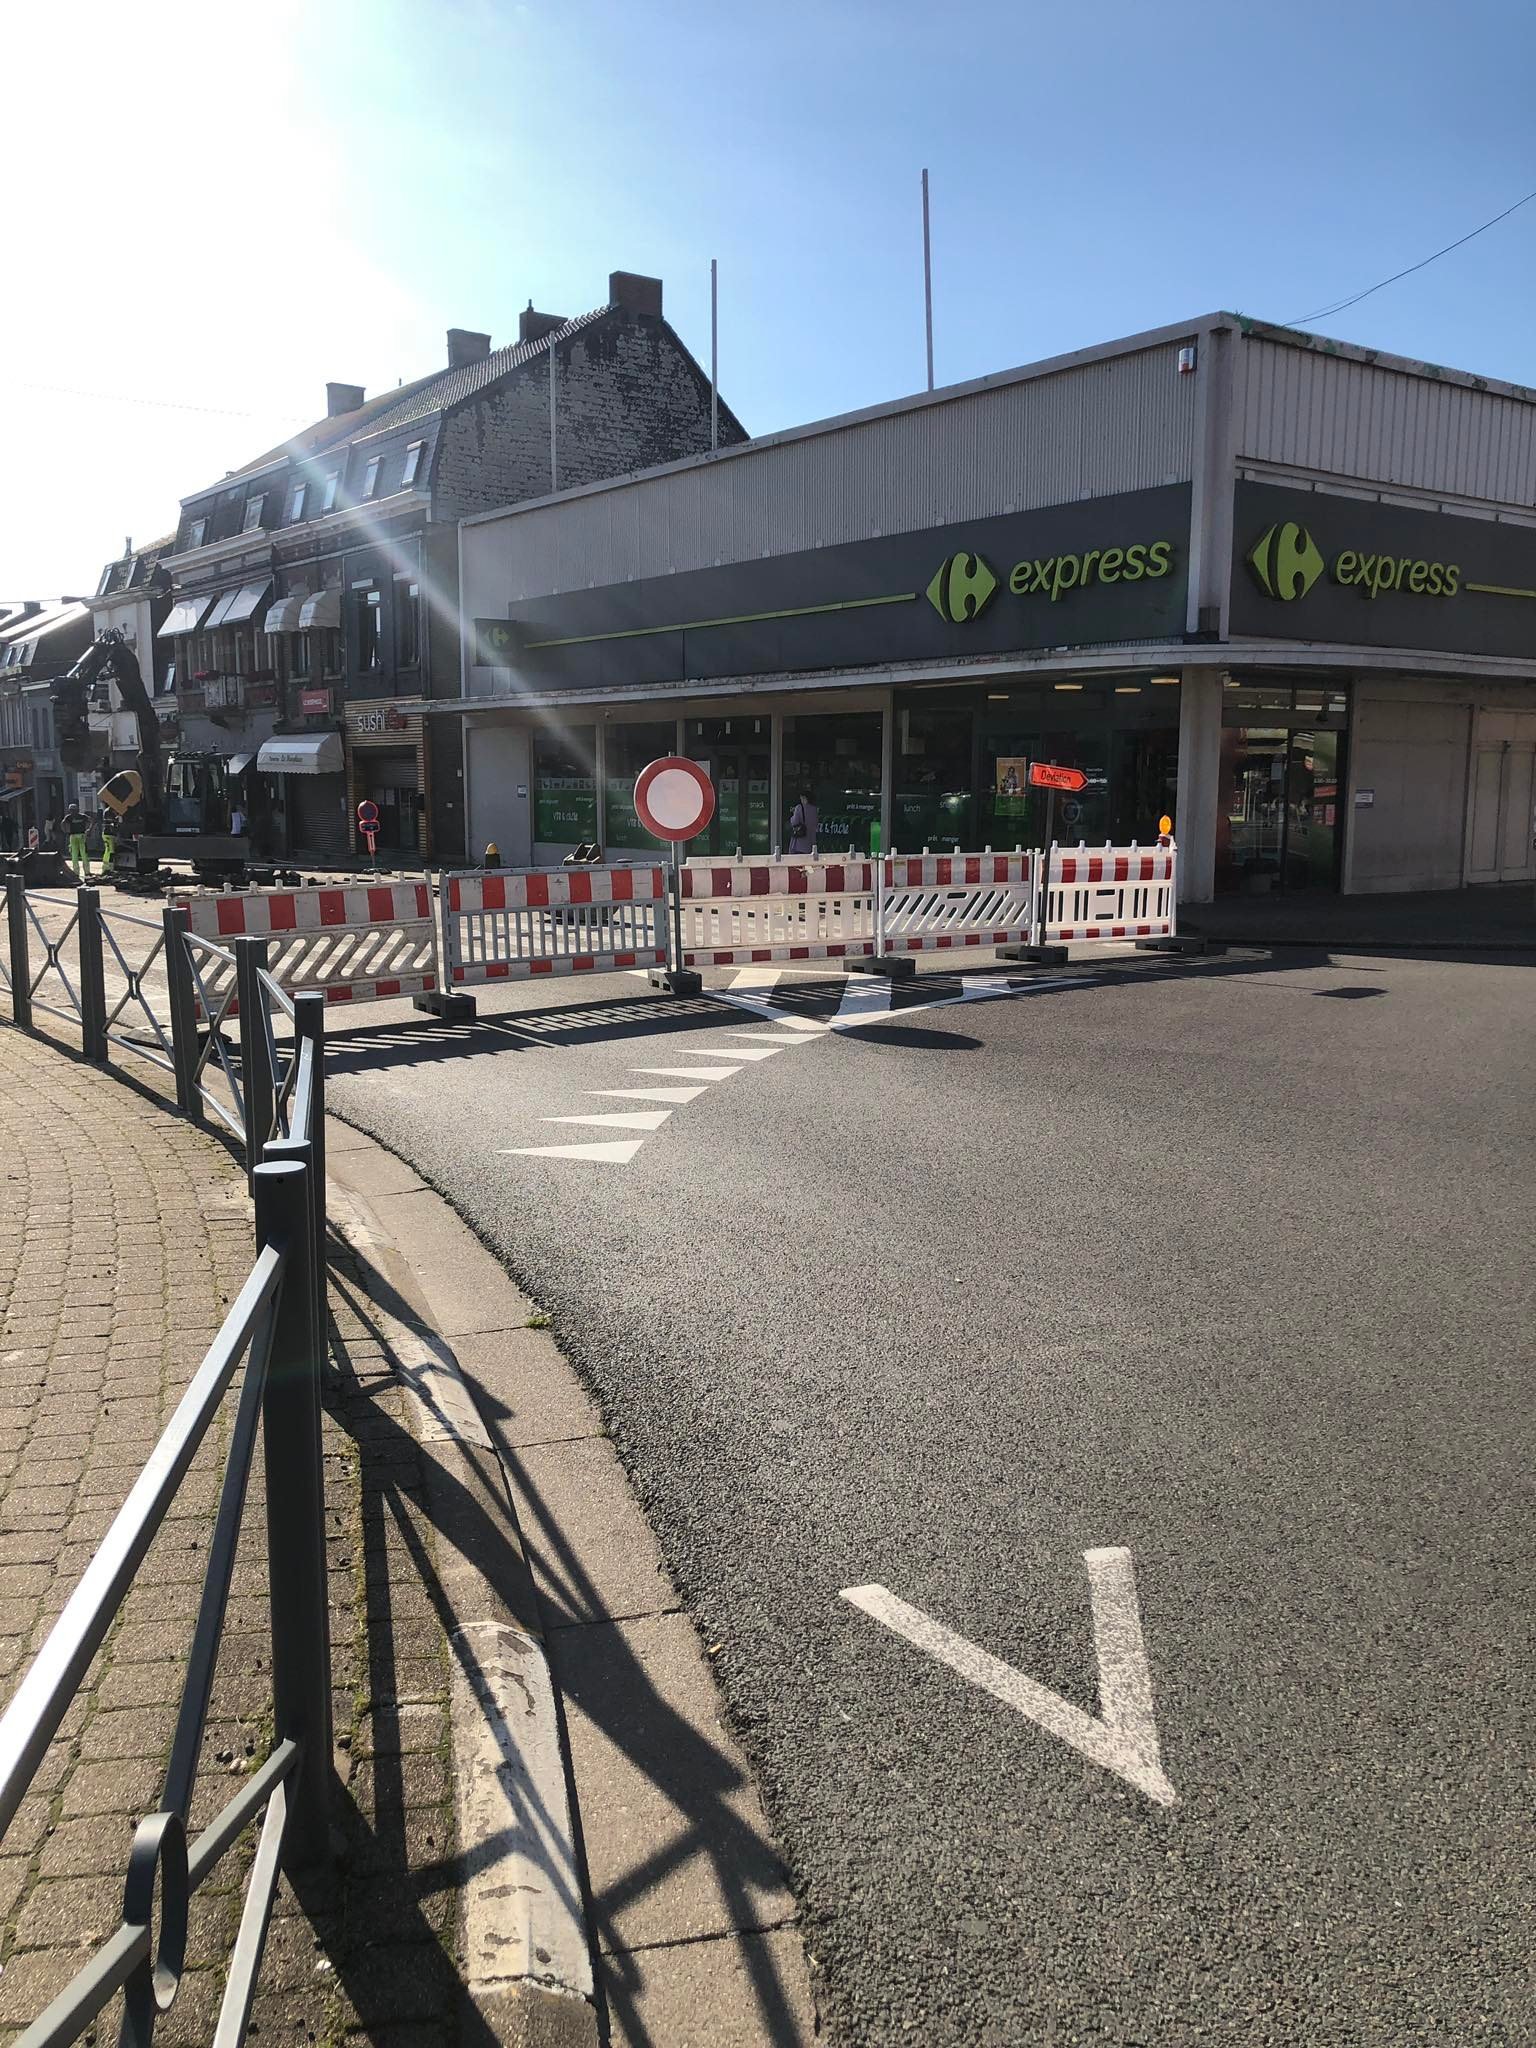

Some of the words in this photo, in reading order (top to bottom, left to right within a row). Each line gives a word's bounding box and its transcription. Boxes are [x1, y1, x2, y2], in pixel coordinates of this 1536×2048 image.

[1010, 541, 1173, 602] express
[1336, 549, 1461, 600] express
[358, 709, 385, 732] sushi
[903, 803, 921, 813] lunch
